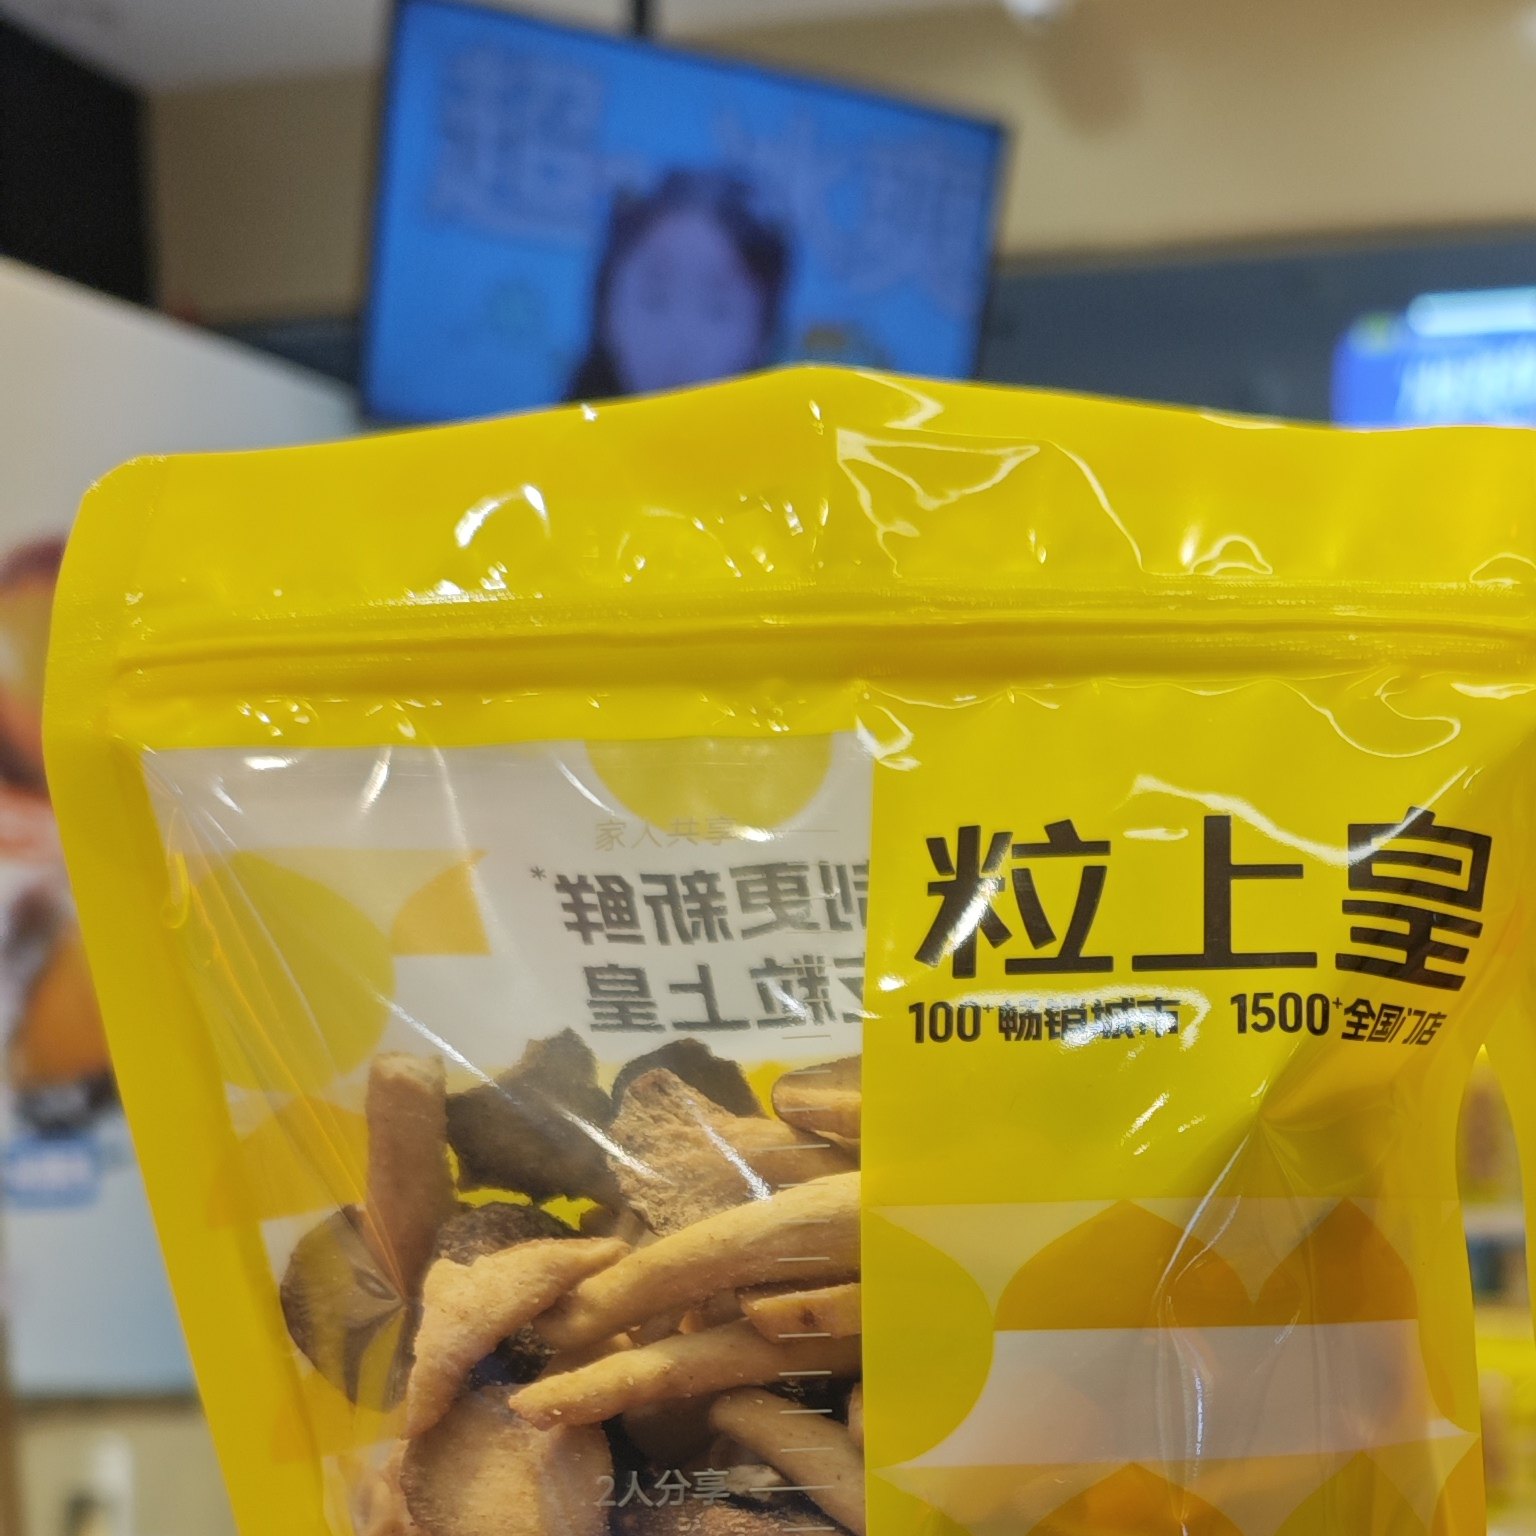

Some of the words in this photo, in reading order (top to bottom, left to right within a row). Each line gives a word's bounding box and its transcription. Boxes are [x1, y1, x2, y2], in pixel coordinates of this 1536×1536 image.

[595, 817, 737, 851] 家人共享
[914, 806, 1492, 991] 粒上皇
[595, 1468, 731, 1507] 2人分享
